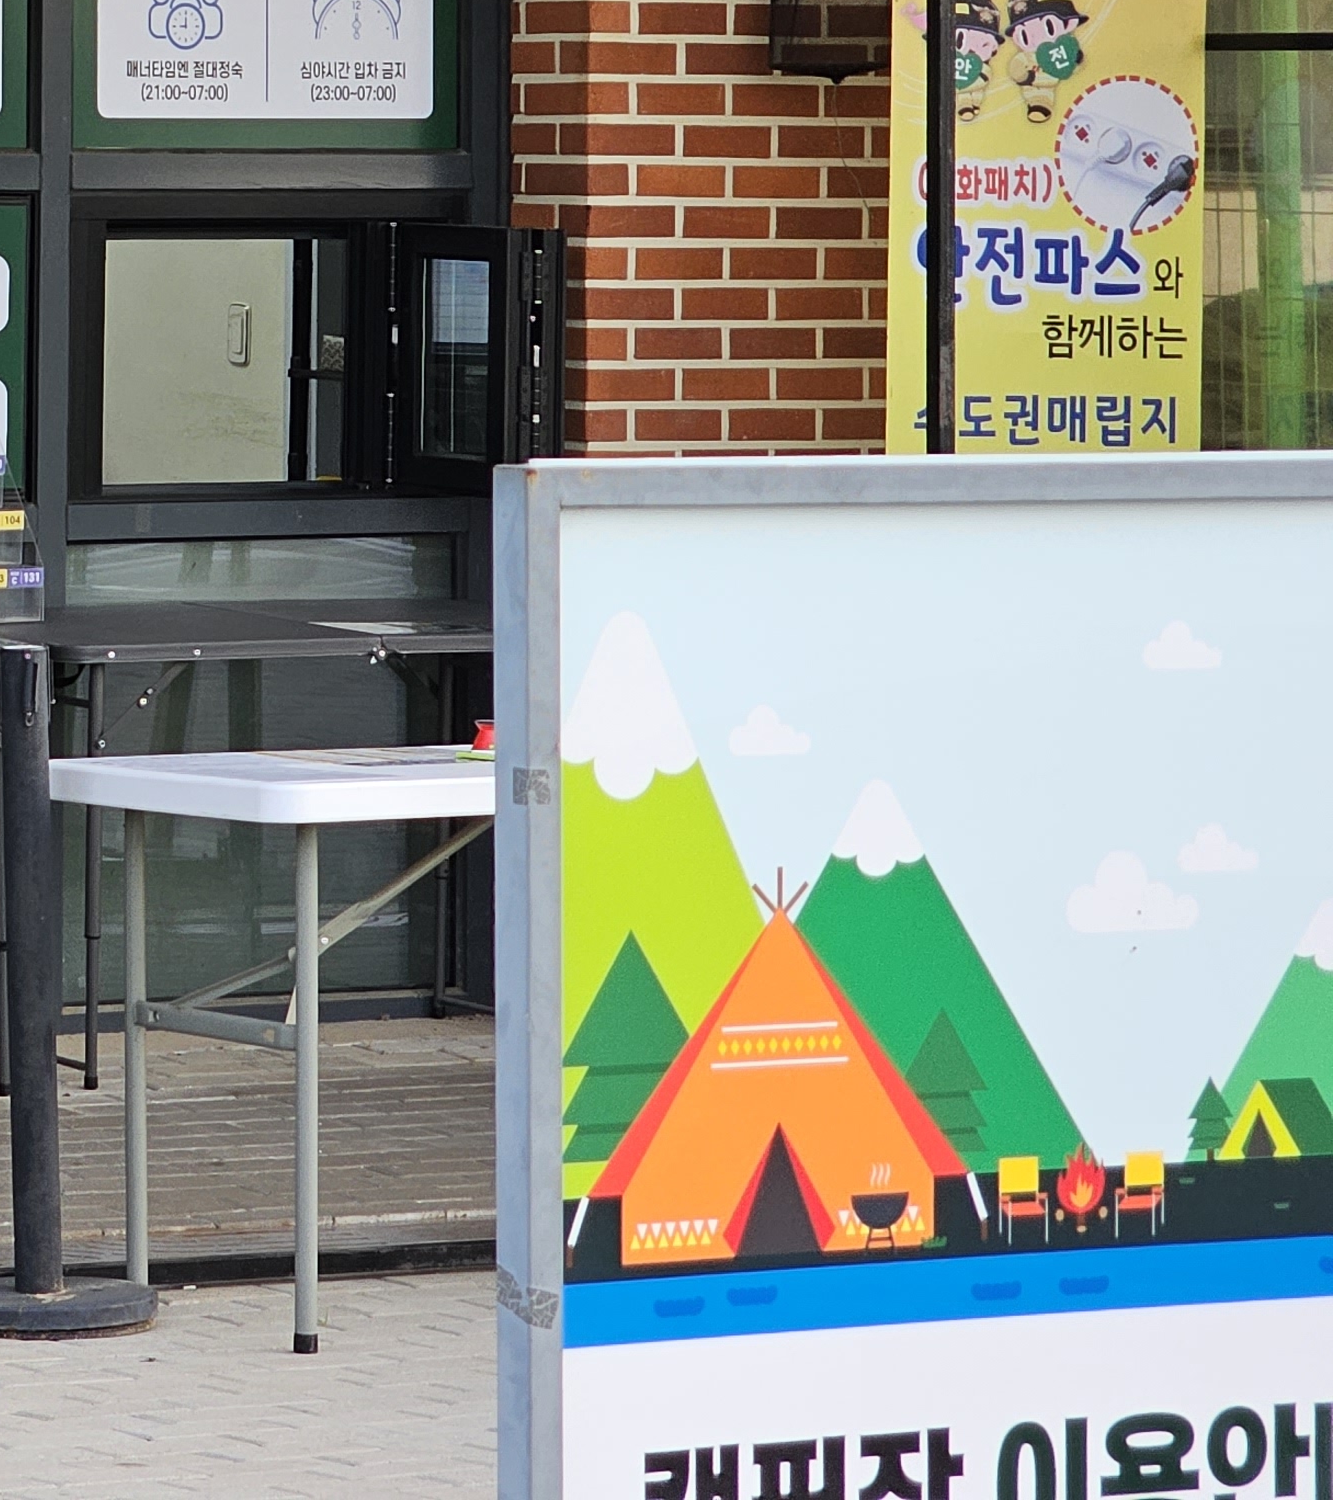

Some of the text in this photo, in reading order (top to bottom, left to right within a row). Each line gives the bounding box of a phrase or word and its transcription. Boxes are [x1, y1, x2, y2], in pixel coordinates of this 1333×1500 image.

[1048, 45, 1071, 69] 전
[126, 59, 244, 80] 매너타임엔 절대정숙
[300, 61, 407, 81] 심야시간 입차 금지
[141, 83, 229, 103] (21:00~07:00)
[310, 83, 396, 104] (23:00~07:00)
[918, 162, 1052, 203] (화패치)
[1041, 314, 1188, 359] 함께하는
[4, 515, 21, 526] 104
[996, 1401, 1333, 1500] 이용안
